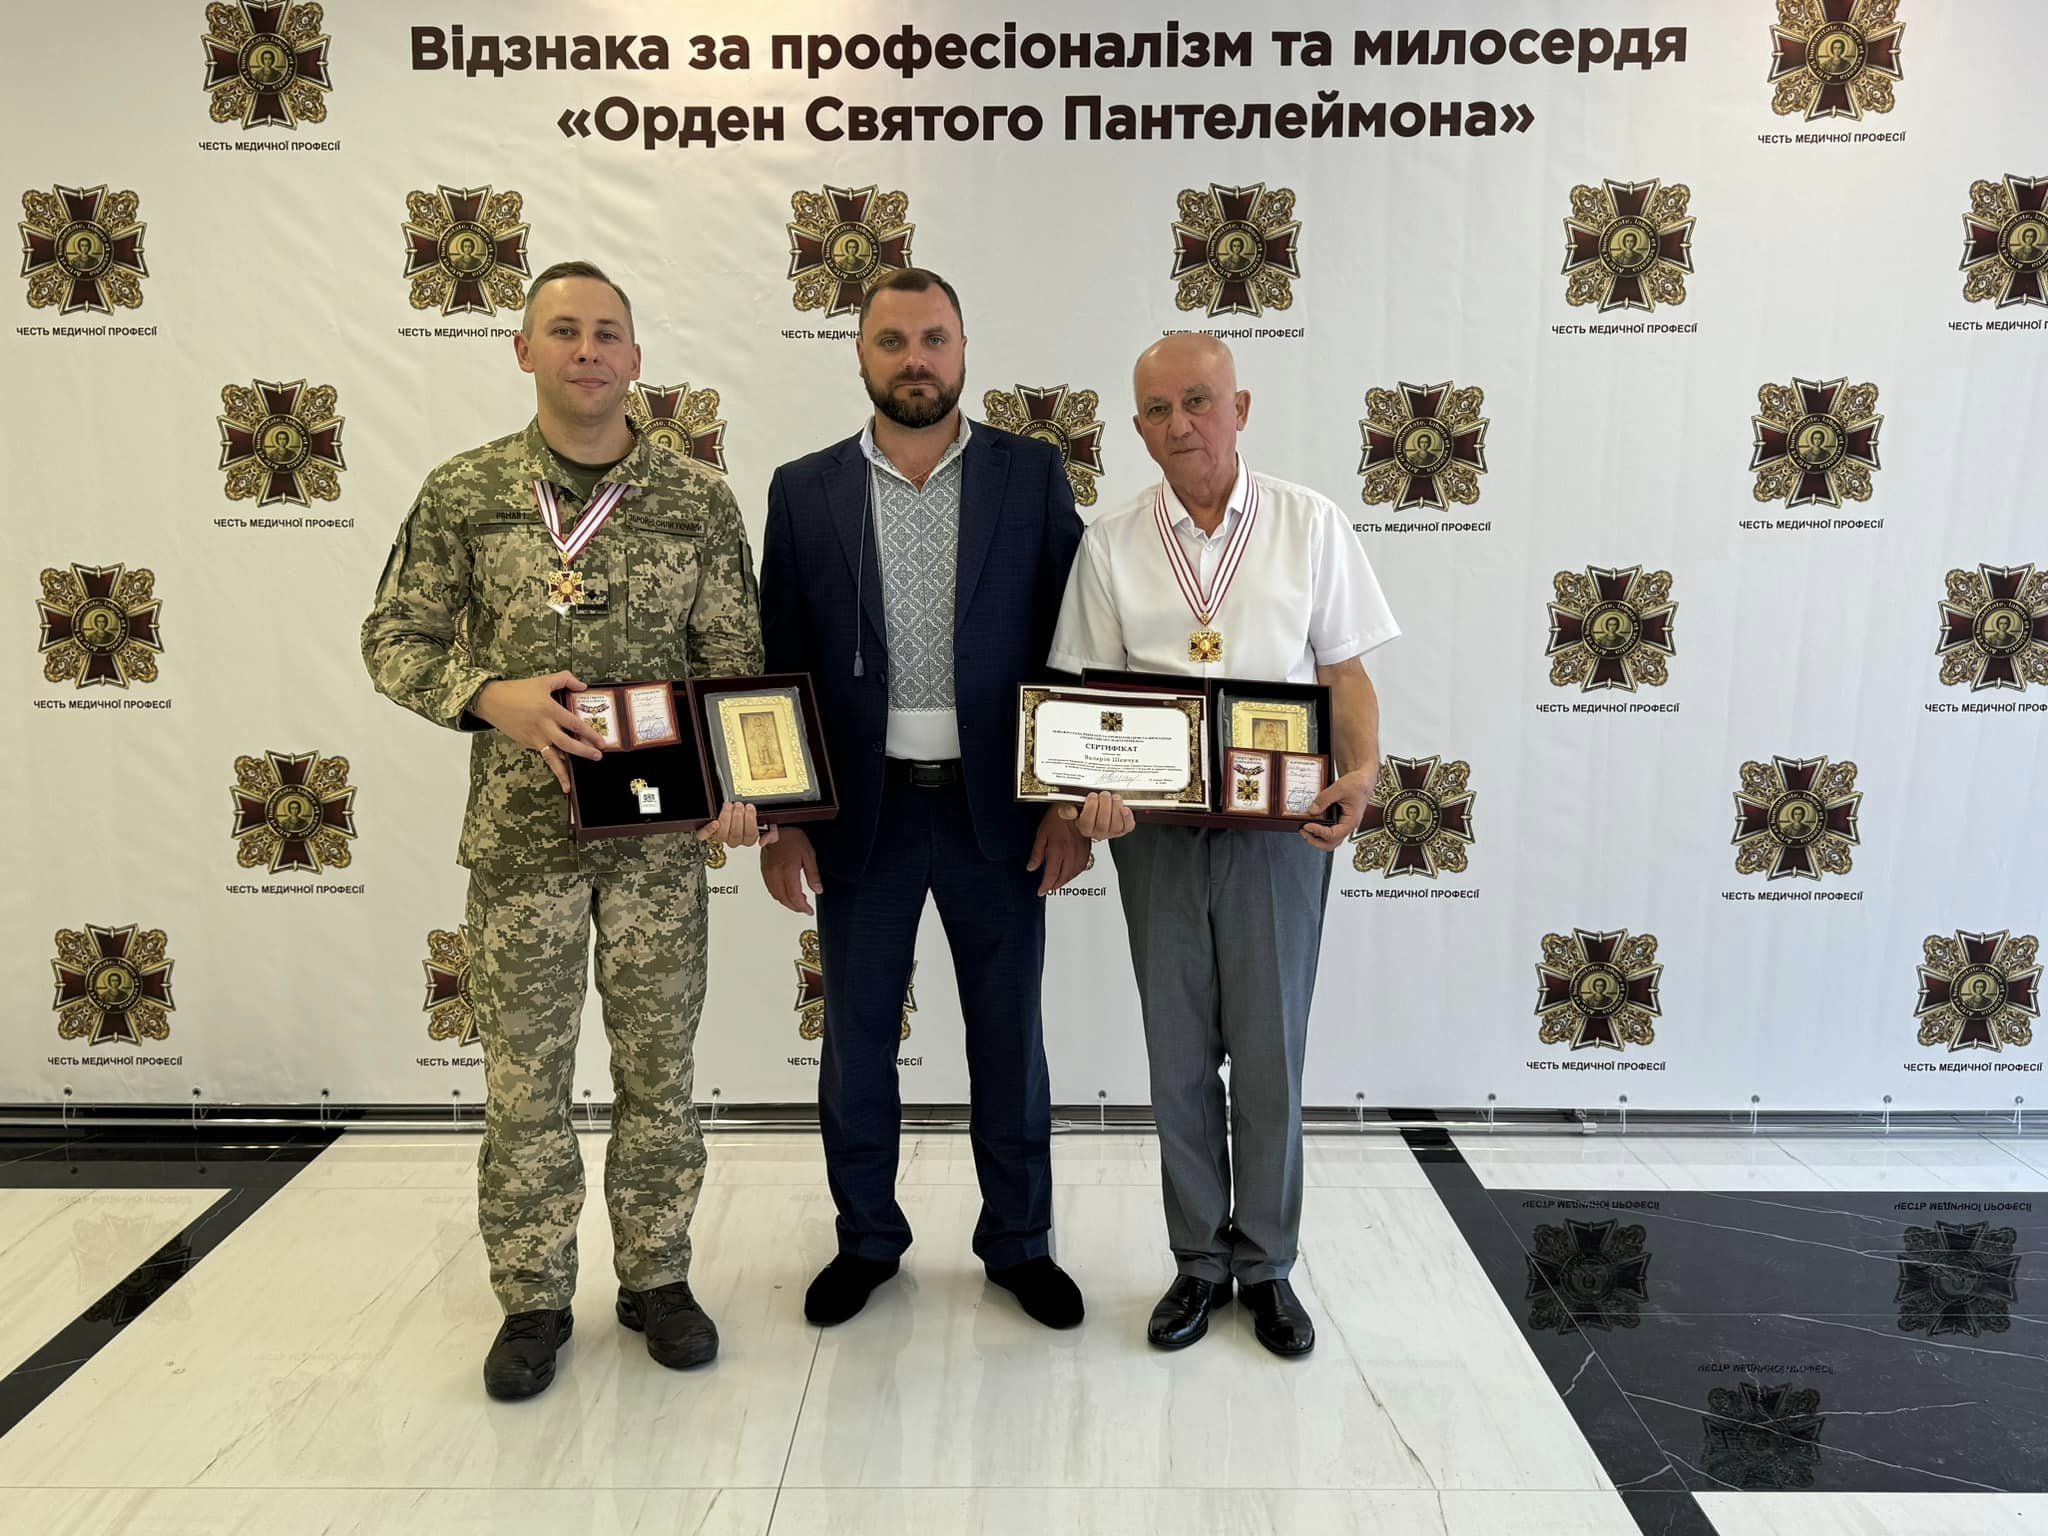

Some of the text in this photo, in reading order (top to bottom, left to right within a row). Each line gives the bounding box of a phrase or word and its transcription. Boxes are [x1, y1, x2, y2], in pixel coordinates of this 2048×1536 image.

[411, 20, 1687, 79] Відзнака за професіоналізм та милосердя
[557, 90, 1535, 150] «Орден Святого Пантелеймона»
[1757, 130, 1907, 145] ЧЕСТЬ МЕДИЧНОЇ ПРОФЕСІЇ
[198, 139, 341, 153] ЧЕСТЬ МЕДИЧНОЇ ПРОФЕСІЇ
[15, 325, 158, 338] ЧЕСТЬ МЕДИЧНОЇ ПРОФЕСІЇ
[1551, 322, 1699, 337] ЧЕСТЬ МЕДИЧНОЇ ПРОФЕСІЇ
[1947, 321, 1984, 332] ЧЕСТЬ
[1985, 319, 2043, 332] МЕДИЧНОЇ
[397, 327, 433, 337] ЧЕСТЬ
[434, 326, 489, 339] МЕДИЧНОЇ
[780, 329, 816, 340] ЧЕСТЬ
[1254, 327, 1305, 339] ПРОФЕСІЇ
[213, 517, 355, 529] ЧЕСТЬ МЕДИЧНОЇ ПРОФЕСІЇ
[1384, 521, 1440, 534] МЕДИЧНОЇ
[1440, 520, 1492, 532] ПРОФЕСІЇ
[1738, 518, 1885, 531] ЧЕСТЬ МЕДИЧНОЇ ПРОФЕСІЇ
[33, 698, 172, 711] ЧЕСТЬ МЕДИЧНОЇ ПРОФЕСІЇ
[1535, 702, 1681, 715] ЧЕСТЬ МЕДИЧНОЇ ПРОФЕСІЇ
[1924, 703, 1960, 713] ЧЕСТЬ
[1961, 701, 2017, 714] МЕДИЧНОЇ
[1085, 743, 1138, 752] СЕРТИФІКАТ
[225, 883, 365, 896] ЧЕСТЬ МЕДИЧНОЇ ПРОФЕСІЇ
[1059, 887, 1107, 897] ПРОФЕСІЇ
[1339, 888, 1481, 900] ЧЕСТЬ МЕДИЧНОЇ ПРОФЕСІЇ
[1721, 890, 1864, 902] ЧЕСТЬ МЕДИЧНОЇ ПРОФЕСІЇ
[47, 1055, 183, 1068] ЧЕСТЬ МЕДИЧНОЇ ПРОФЕСІЇ
[415, 1057, 450, 1067] ЧЕСТЬ
[787, 1056, 820, 1067] ЧЕСТЬ
[1525, 1060, 1667, 1072] ЧЕСТЬ МЕДИЧНОЇ ПРОФЕСІЇ
[1903, 1061, 2044, 1073] ЧЕСТЬ МЕДИЧНОЇ ПРОФЕСІЇ
